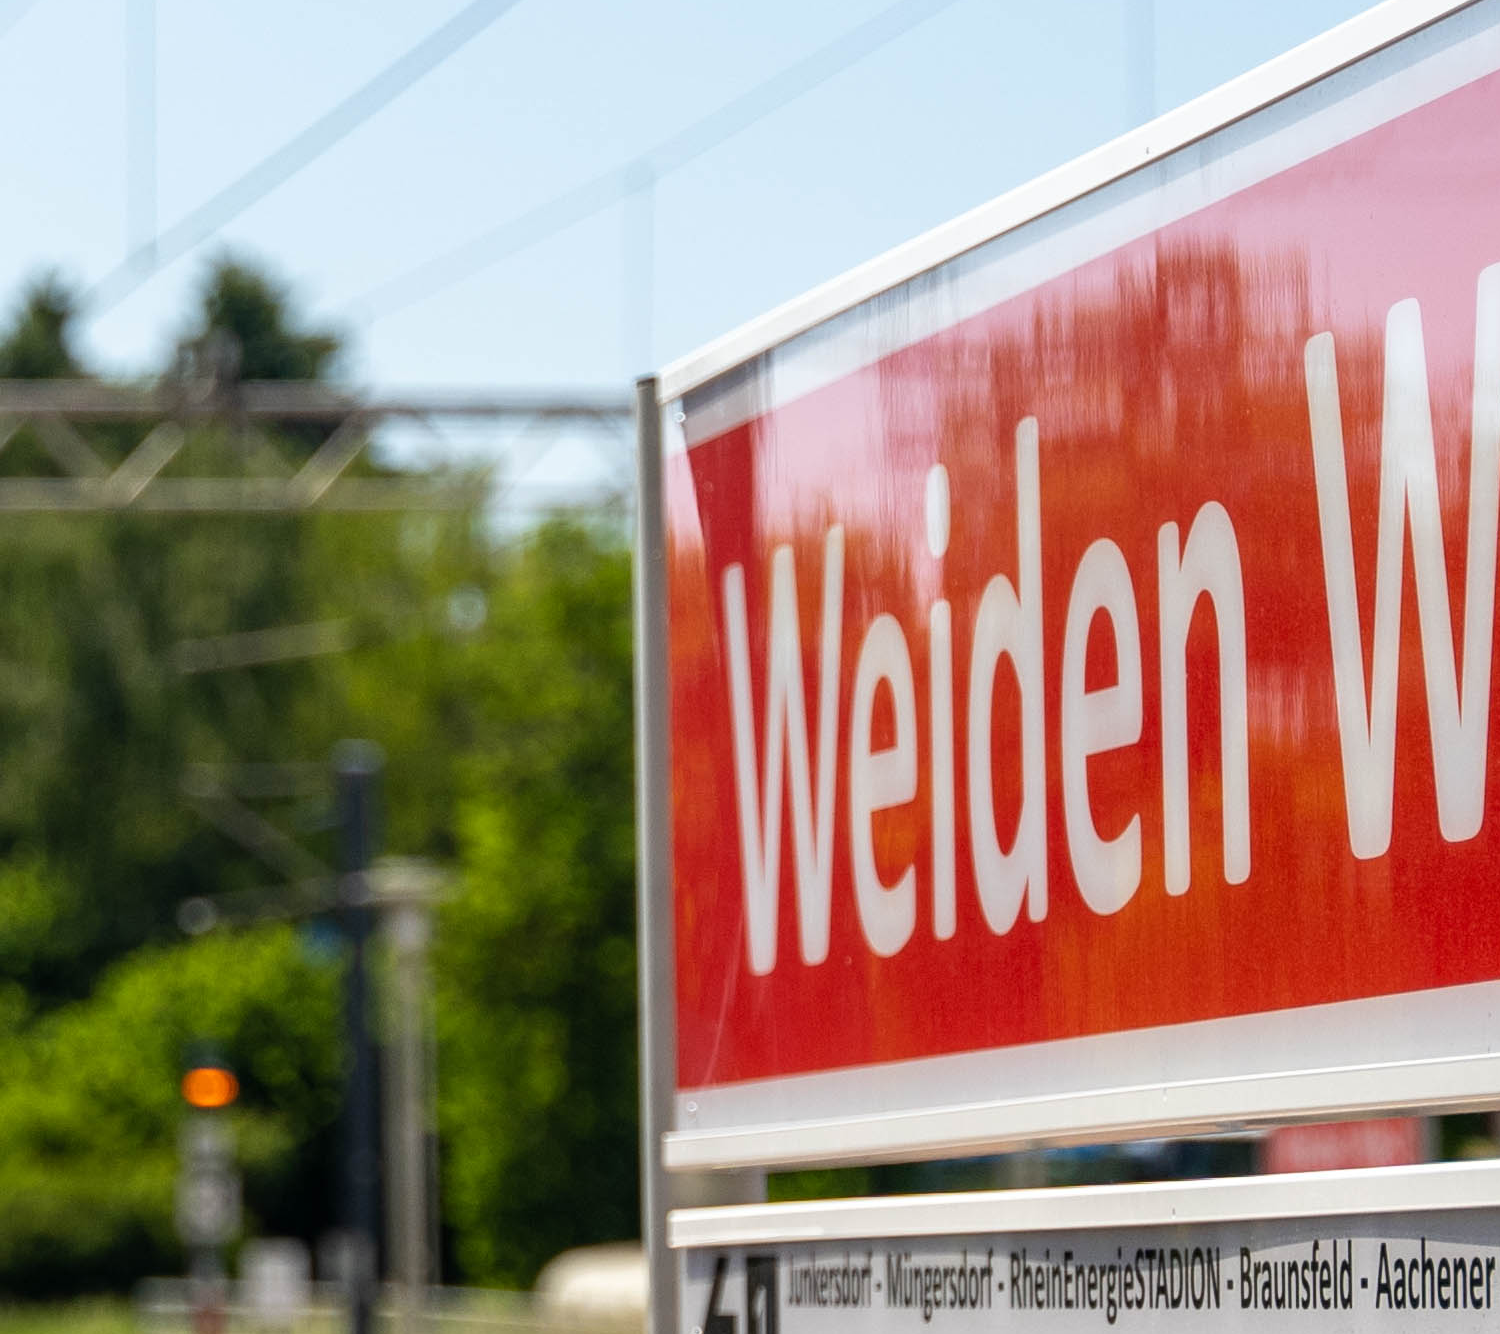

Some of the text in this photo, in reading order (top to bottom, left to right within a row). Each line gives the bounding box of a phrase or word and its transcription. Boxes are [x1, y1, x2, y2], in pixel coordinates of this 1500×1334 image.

[722, 415, 1250, 977] Weiden
[885, 1246, 995, 1322] Müngersdorf
[1009, 1245, 1221, 1325] RheinEnergieSTADION
[1239, 1238, 1353, 1310] Braunsfeld
[1375, 1236, 1496, 1310] Aachener
